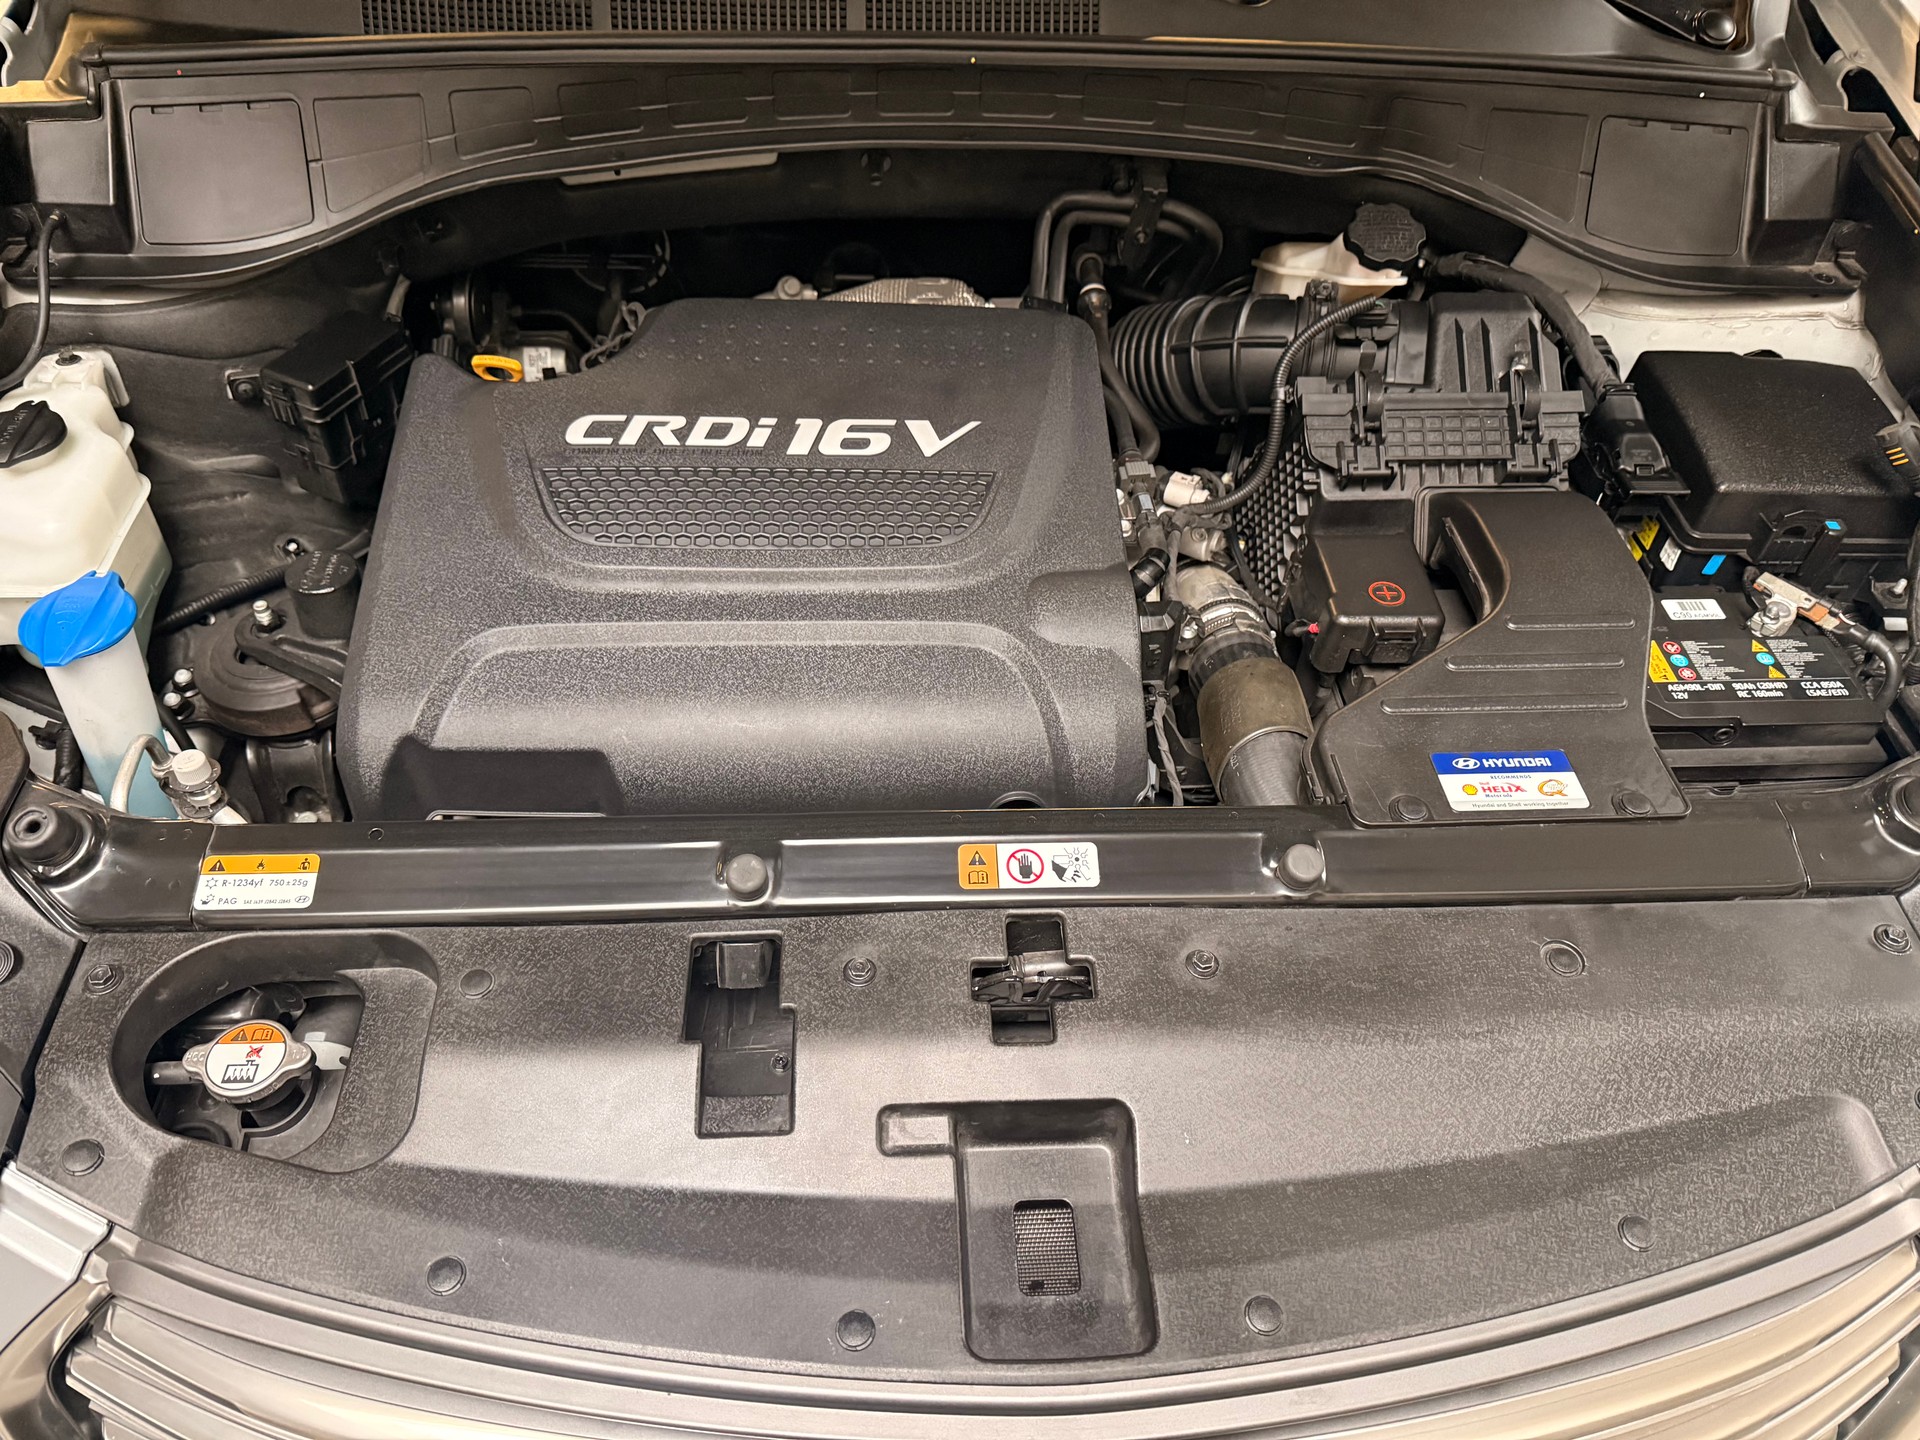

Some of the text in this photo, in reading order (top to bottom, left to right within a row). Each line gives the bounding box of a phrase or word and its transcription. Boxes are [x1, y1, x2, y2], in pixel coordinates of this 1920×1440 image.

[565, 414, 778, 447] CRDi
[1731, 682, 1757, 691] 90Ah
[1757, 681, 1788, 690] (20HR)
[1800, 681, 1821, 689] CCA
[1671, 688, 1850, 700] 12V RC 160min (SAE/EN)
[1482, 757, 1552, 768] HYUNDAI
[1481, 784, 1528, 793] HELIX
[221, 878, 264, 888] R-1234yf
[217, 897, 238, 905] PAG
[185, 1051, 206, 1061] HCC
